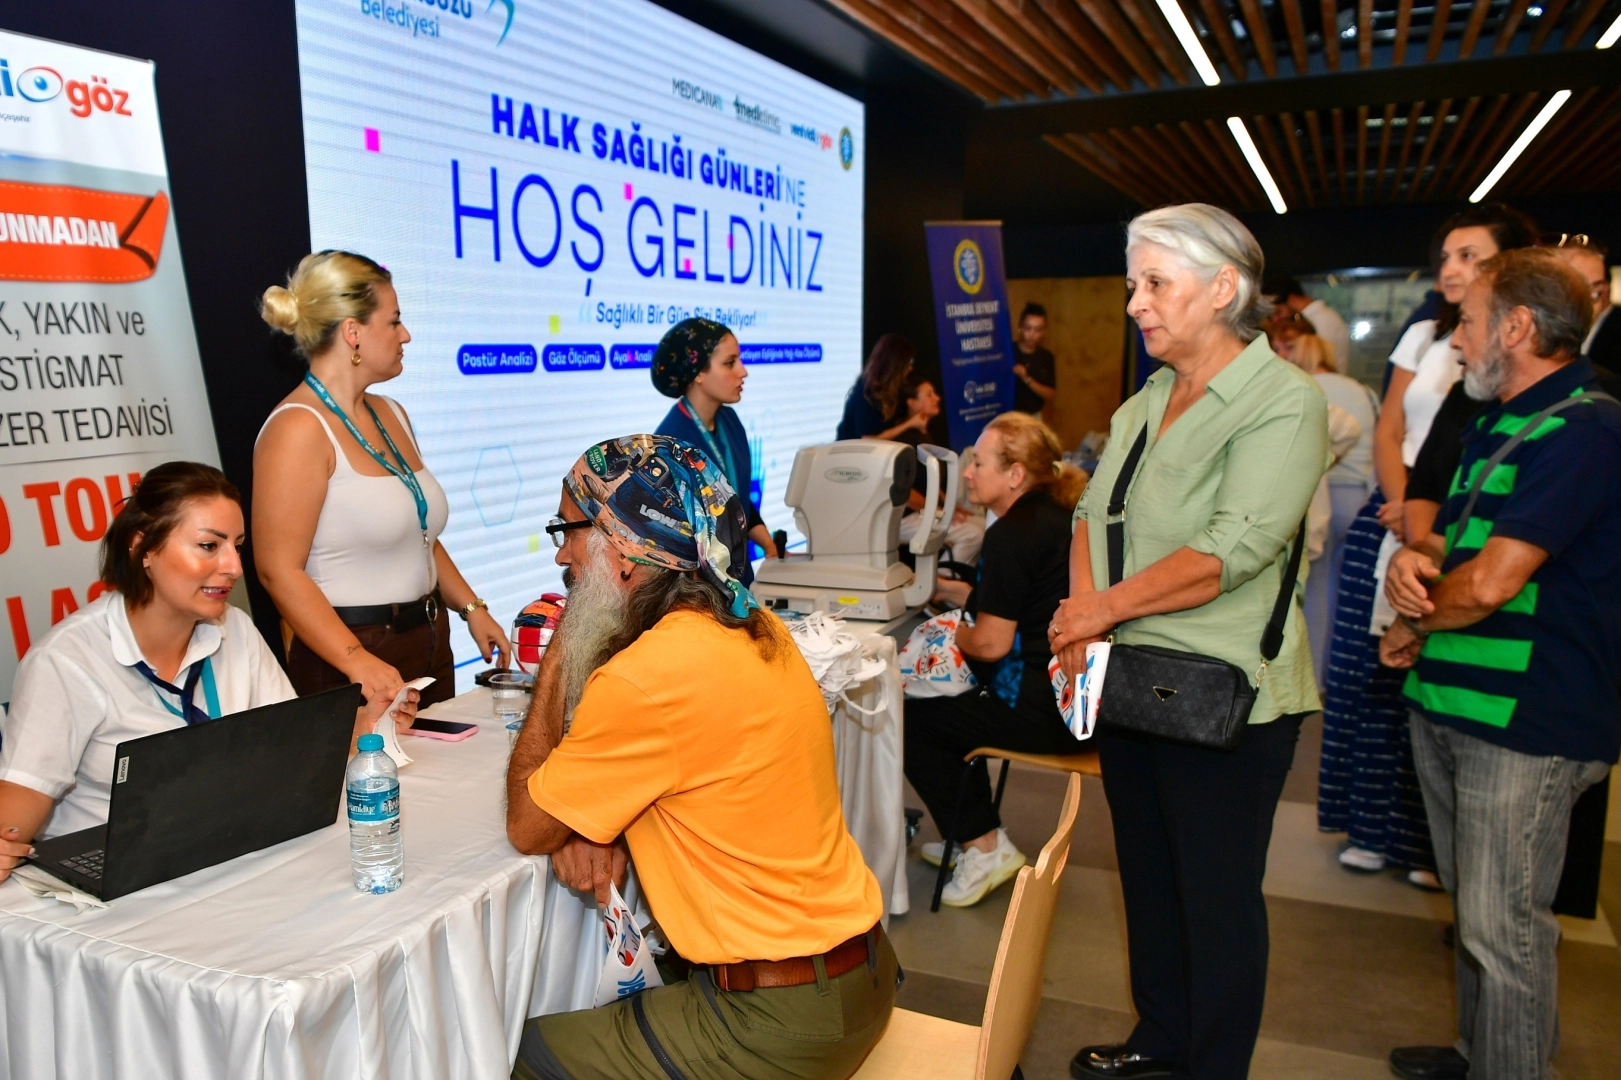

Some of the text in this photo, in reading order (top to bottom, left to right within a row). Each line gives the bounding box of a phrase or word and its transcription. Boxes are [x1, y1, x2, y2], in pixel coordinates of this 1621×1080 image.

[360, 0, 440, 38] Belediyesi
[65, 75, 132, 118] göz
[672, 78, 718, 110] MEDICANA
[491, 92, 806, 208] HALK SAĞLIĞI GÜNLERİ'NE
[451, 159, 824, 297] HOŞ GELDİNİZ
[23, 300, 111, 335] YAKIN
[116, 312, 145, 336] ve
[596, 301, 644, 330] Sağlıklı
[647, 304, 664, 325] Bir
[667, 304, 690, 325] Gün
[462, 351, 534, 368] Postür Analizi
[549, 347, 601, 367] Göz Ölçümü
[52, 398, 174, 442] TEDAVİSİ
[593, 448, 602, 464] LAND
[639, 503, 678, 530] LOW
[119, 758, 127, 782] Lenovo
